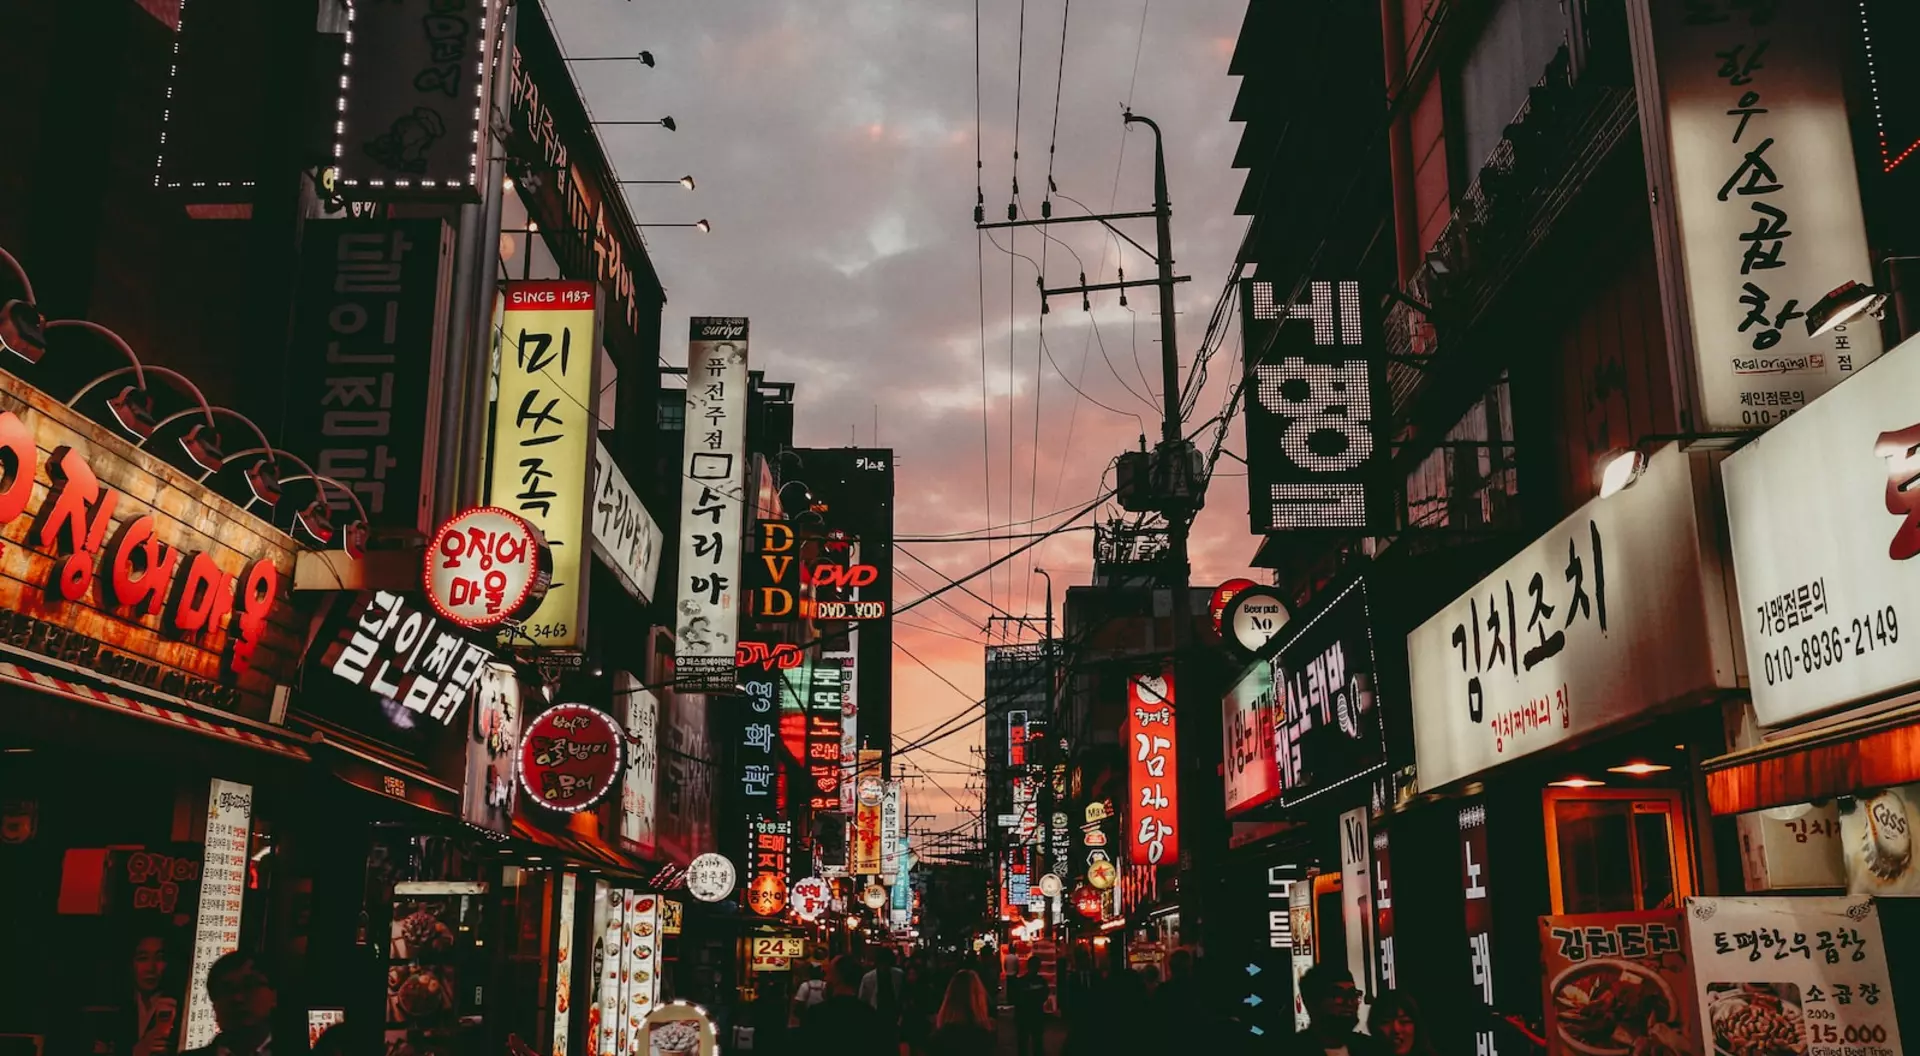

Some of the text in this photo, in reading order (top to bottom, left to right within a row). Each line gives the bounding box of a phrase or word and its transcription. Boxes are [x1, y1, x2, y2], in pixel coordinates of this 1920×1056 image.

[512, 291, 591, 304] SINCE 1987
[701, 324, 744, 339] suriya
[320, 230, 413, 513] 달인찜닭
[1732, 358, 1759, 370] Real
[703, 357, 728, 450] 퓨전주점
[1740, 391, 1805, 406] 체인점문의
[597, 474, 641, 562] 수리야
[440, 526, 527, 572] 오징어
[691, 487, 729, 605] 수리야
[761, 523, 794, 616] DVD
[813, 564, 878, 588] DVD
[449, 571, 508, 615] 마을
[1757, 577, 1828, 637] 가맹점문의
[1244, 604, 1278, 615] Beer pub
[1452, 519, 1607, 724] 김치조치
[534, 623, 567, 638] 3463
[1764, 605, 1899, 686] 010-8936-2149
[333, 590, 494, 727] 달인찜닭
[736, 642, 804, 671] DVD
[1135, 708, 1170, 727] 형제들
[1491, 682, 1569, 753] 김치찌개의 집
[1136, 733, 1174, 866] 감자탕
[756, 822, 786, 834] 영등포
[1873, 803, 1907, 836] Cass
[128, 851, 199, 884] 오징어
[690, 870, 728, 884] 퓨전주점
[134, 882, 179, 913] 마을
[751, 890, 784, 904] 품앗이
[759, 940, 784, 955] 24
[1808, 1009, 1835, 1020] 200g
[1810, 1024, 1887, 1045] 15,000
